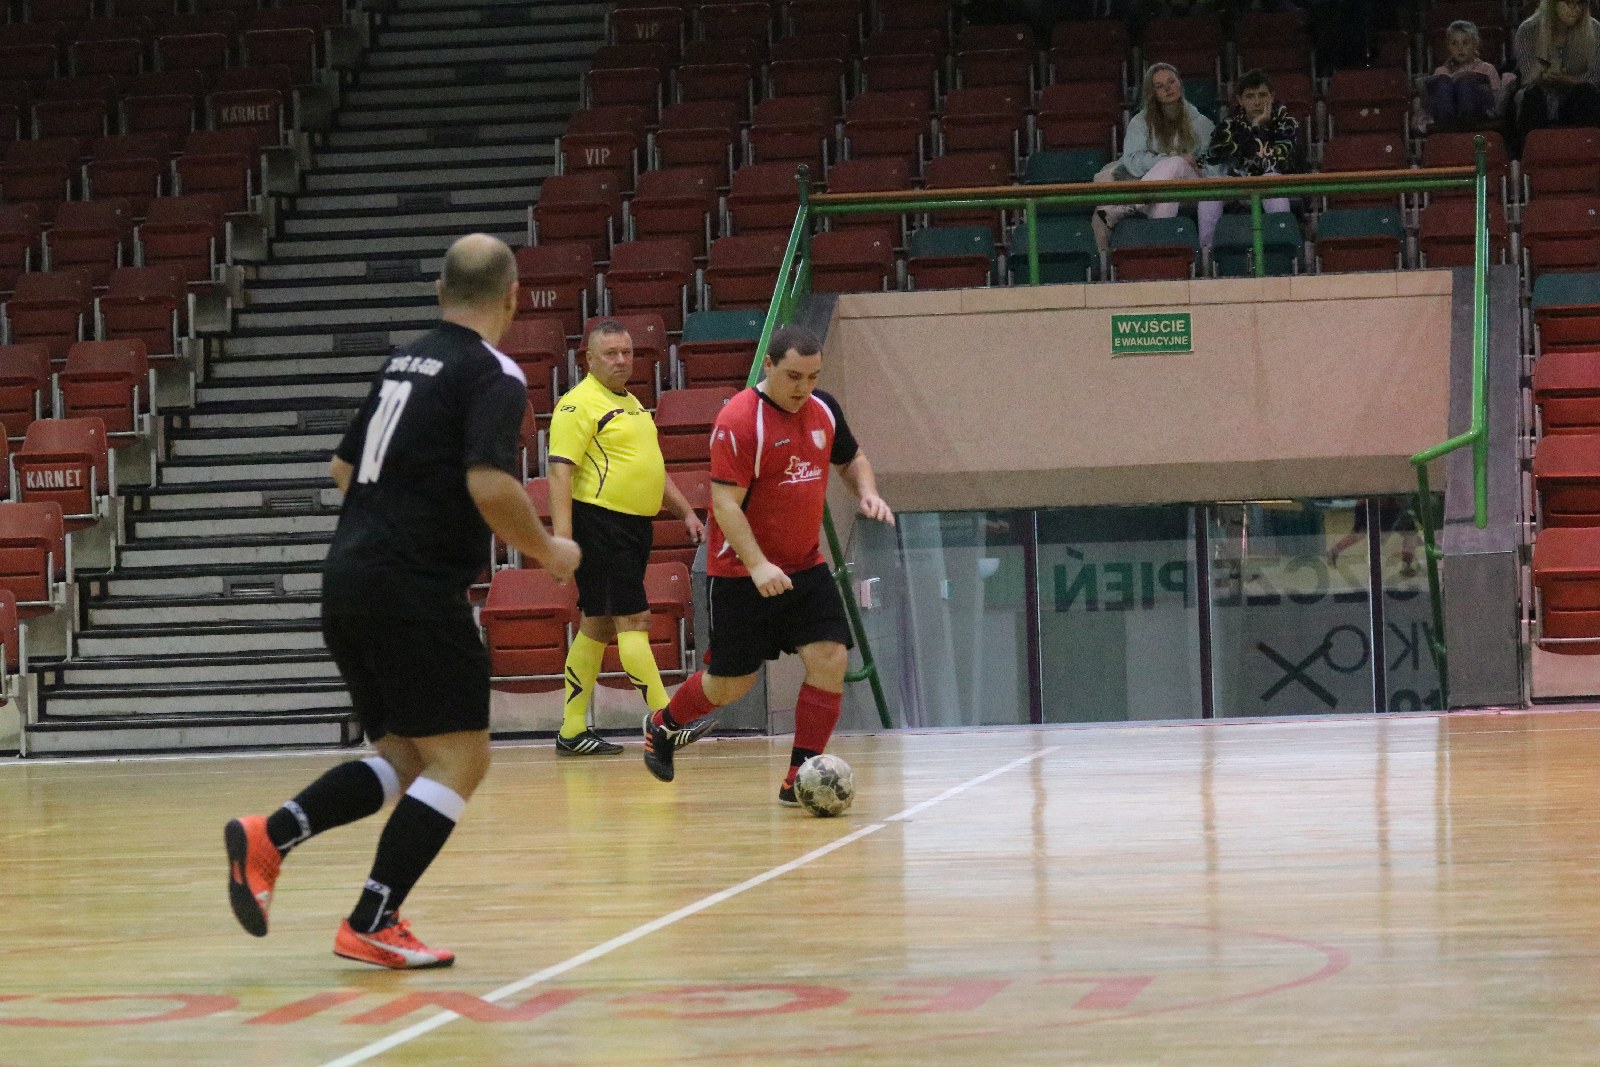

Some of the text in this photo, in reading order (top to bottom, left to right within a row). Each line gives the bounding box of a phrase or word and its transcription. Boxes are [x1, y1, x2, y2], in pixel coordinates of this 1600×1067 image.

[635, 23, 659, 38] VIP
[222, 105, 270, 122] KARNET
[585, 148, 610, 165] VIP
[531, 290, 557, 308] VIP
[1117, 317, 1186, 334] WYJŚCIE
[1114, 336, 1189, 347] EWAKUACYJNE
[26, 469, 82, 489] KARNET
[0, 976, 1154, 1028] LEGNIC
